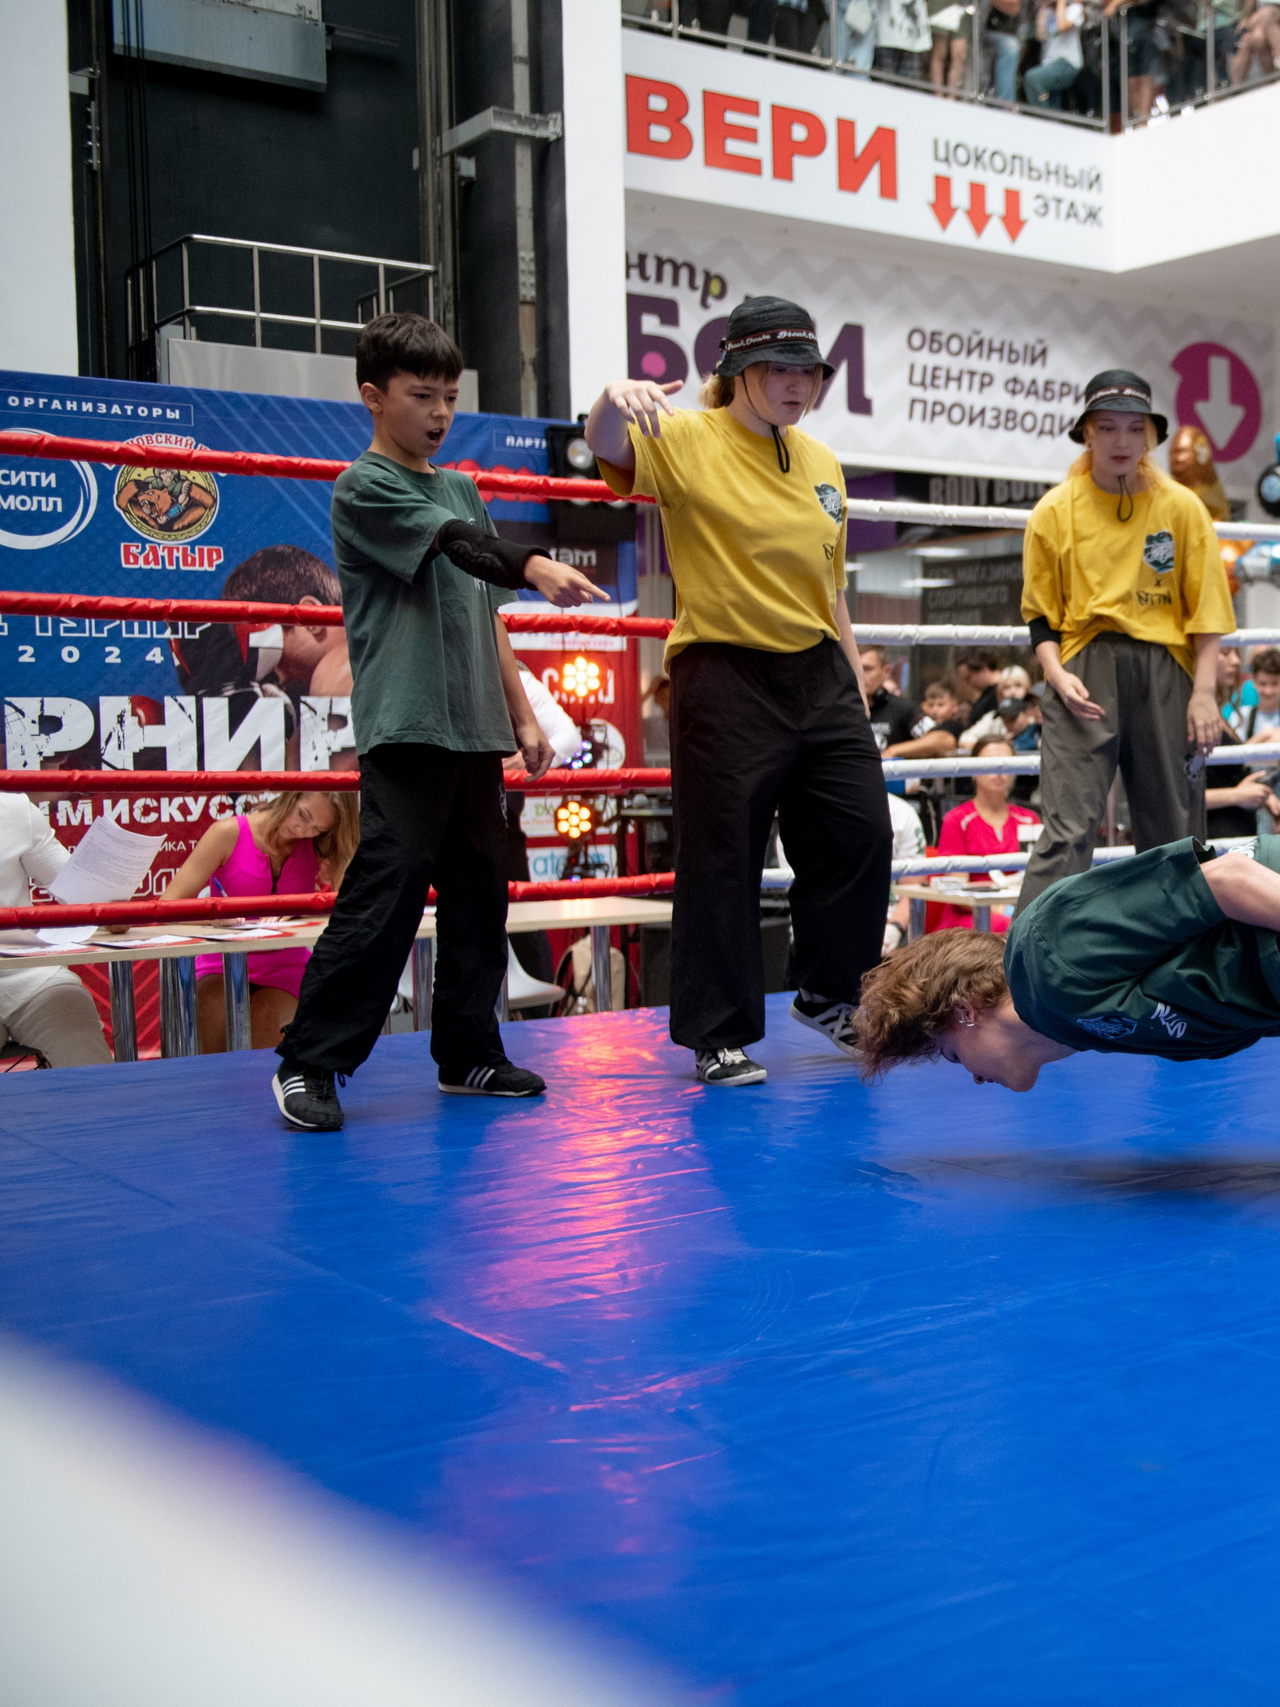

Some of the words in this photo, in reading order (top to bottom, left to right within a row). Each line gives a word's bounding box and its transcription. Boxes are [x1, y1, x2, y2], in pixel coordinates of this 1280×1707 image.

[626, 74, 897, 200] ВЕРИ
[934, 137, 1102, 193] ЦОКОЛЬНЫЙ
[1033, 194, 1103, 227] ЭТАЖ
[907, 327, 1048, 368] ОБОЙНЫЙ
[909, 363, 994, 394] ЦЕНТР
[8, 396, 180, 419] ОРГАНИЗАТОРЫ
[0, 470, 56, 488] СИТИ
[0, 494, 62, 513] МОЛЛ
[121, 543, 224, 570] БАТЫР
[18, 646, 164, 663] 2024
[4, 695, 357, 771] РНИР
